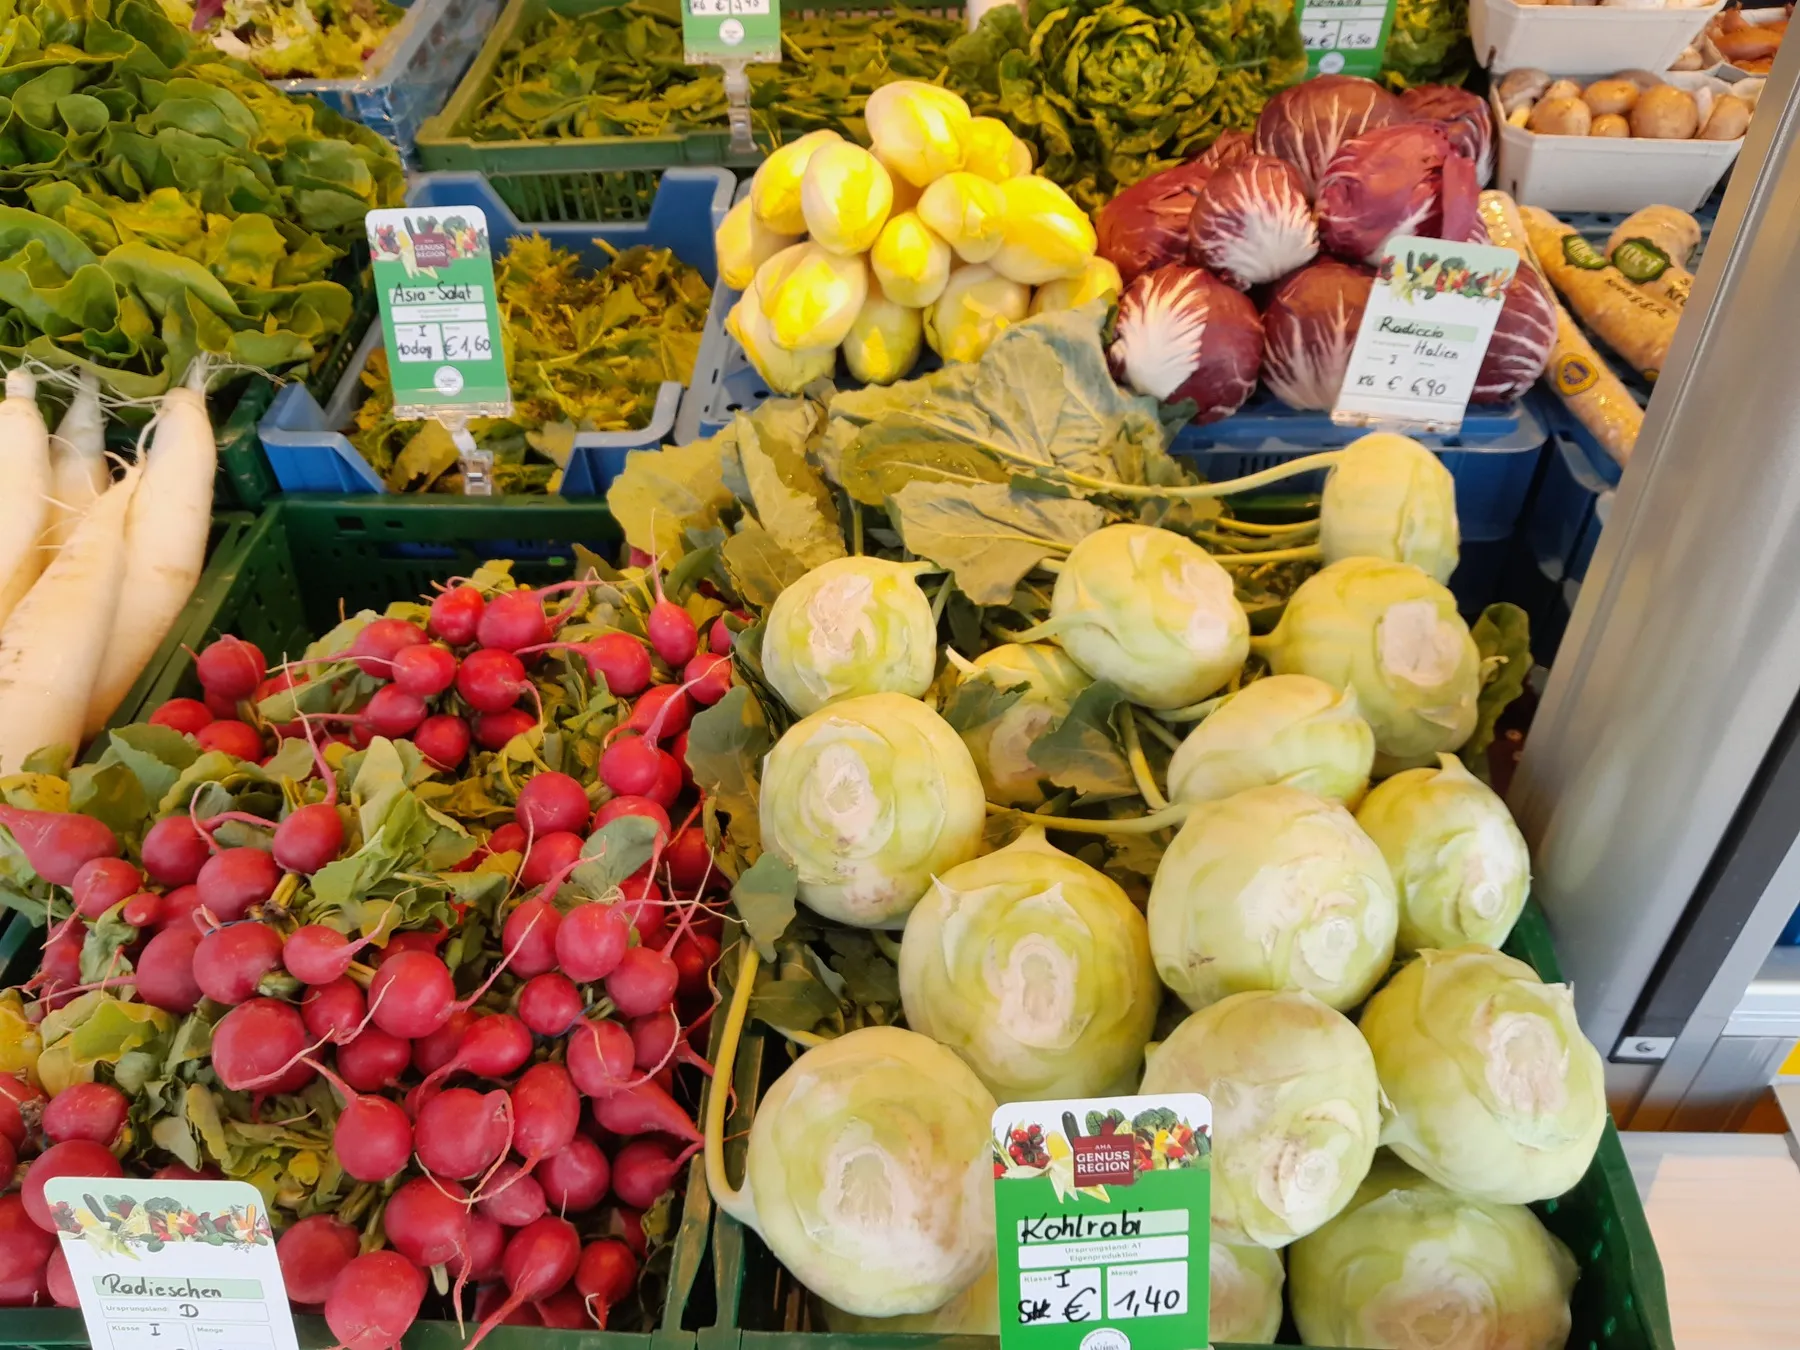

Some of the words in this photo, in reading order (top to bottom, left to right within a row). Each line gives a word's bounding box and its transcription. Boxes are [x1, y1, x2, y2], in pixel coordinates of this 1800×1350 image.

[419, 325, 426, 337] I
[1379, 316, 1445, 338] Radiccio
[443, 336, 458, 357] €
[460, 335, 491, 359] 1,60
[1387, 375, 1403, 391] €
[1410, 377, 1447, 397] 6,90
[1095, 1143, 1112, 1151] AMA
[1076, 1150, 1131, 1164] GENUSS
[1077, 1161, 1130, 1174] REGION
[1021, 1206, 1144, 1245] Kohlrabi
[1069, 1251, 1139, 1263] Eigenproduktion
[1054, 1269, 1071, 1288] I
[1111, 1269, 1139, 1277] Menge
[101, 1273, 223, 1300] Radieschen
[179, 1303, 199, 1318] D
[1062, 1286, 1097, 1323] €
[1113, 1285, 1181, 1317] 1,40
[149, 1323, 161, 1336] I
[197, 1326, 224, 1334] Menge
